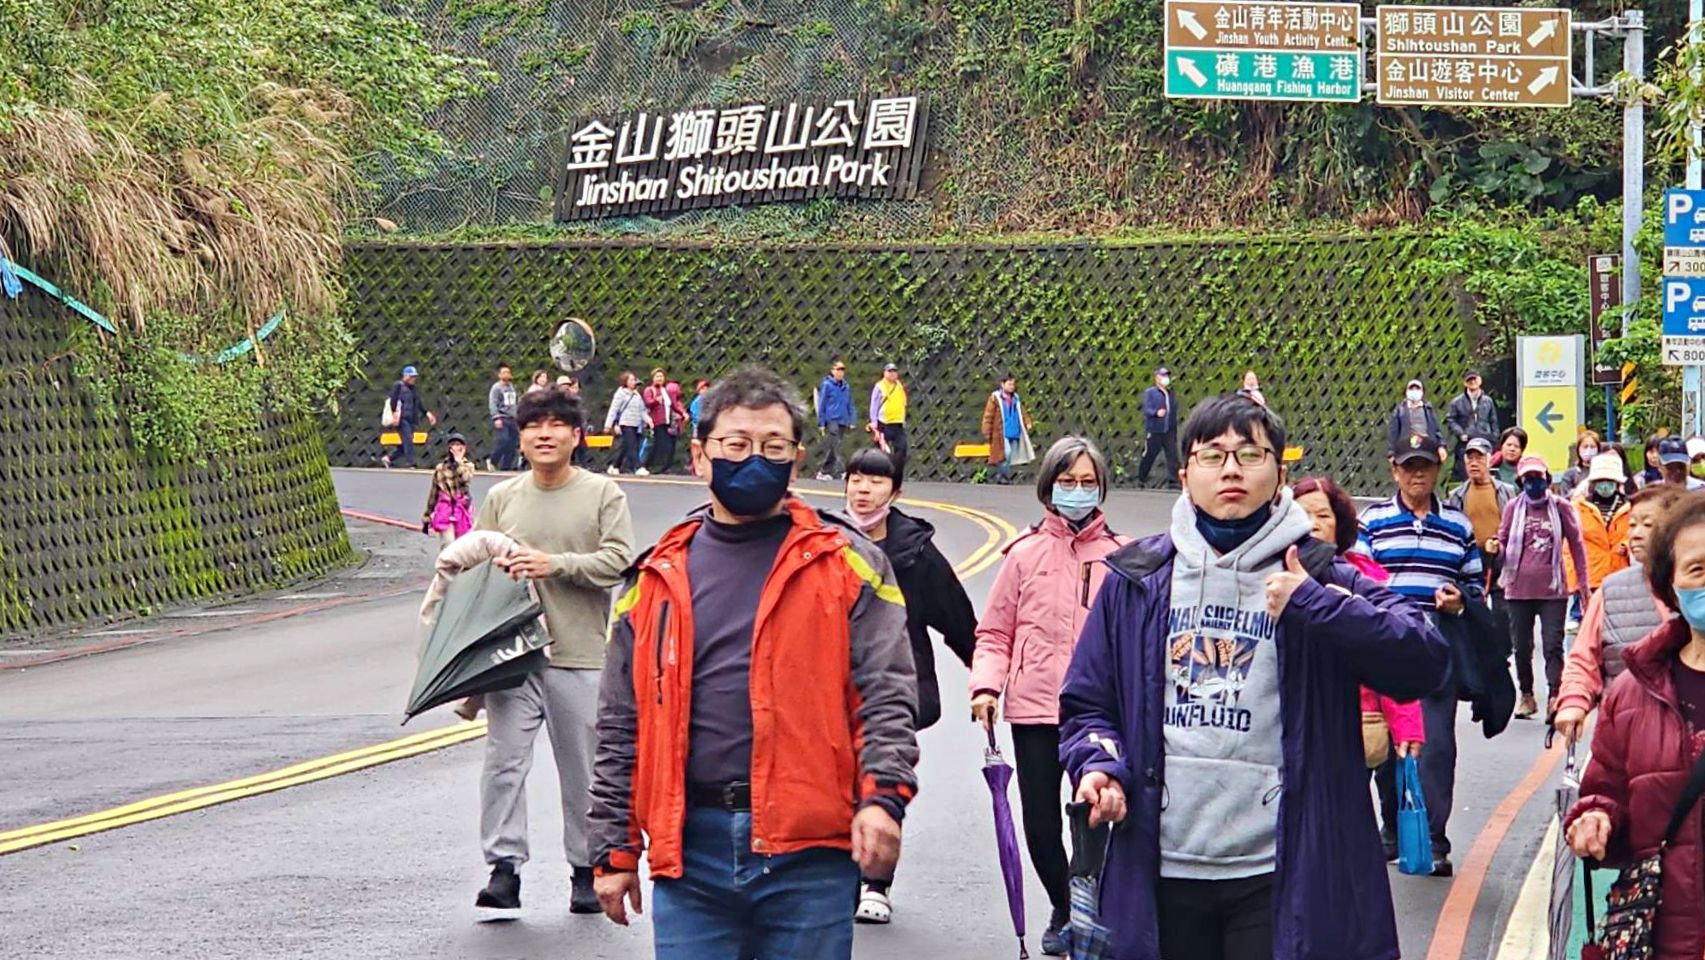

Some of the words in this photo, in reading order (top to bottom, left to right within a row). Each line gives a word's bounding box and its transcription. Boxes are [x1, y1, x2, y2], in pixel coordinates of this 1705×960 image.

[1213, 5, 1354, 32] 金山青年活動中心
[1384, 12, 1522, 37] 獅頭山公園
[1214, 31, 1249, 46] Jinshan
[1253, 32, 1279, 46] Youth
[1283, 33, 1320, 49] Activity
[1386, 38, 1477, 52] Shihtoushan
[1486, 40, 1521, 54] Park
[1215, 53, 1354, 80] 磺港漁港
[1385, 58, 1523, 84] 金山遊客中心
[1217, 79, 1271, 97] Huanggang
[1276, 80, 1312, 97] Fishing
[1317, 82, 1352, 96] Harbor
[1385, 85, 1429, 99] Jinshan
[1436, 86, 1475, 100] Visitor
[1481, 87, 1520, 101] Center
[567, 97, 918, 170] 金山獅頭山公園
[576, 170, 668, 206] Jinshan
[677, 157, 820, 199] Shitoushan
[824, 153, 891, 186] Park
[1669, 194, 1693, 224] P
[1667, 282, 1691, 313] P
